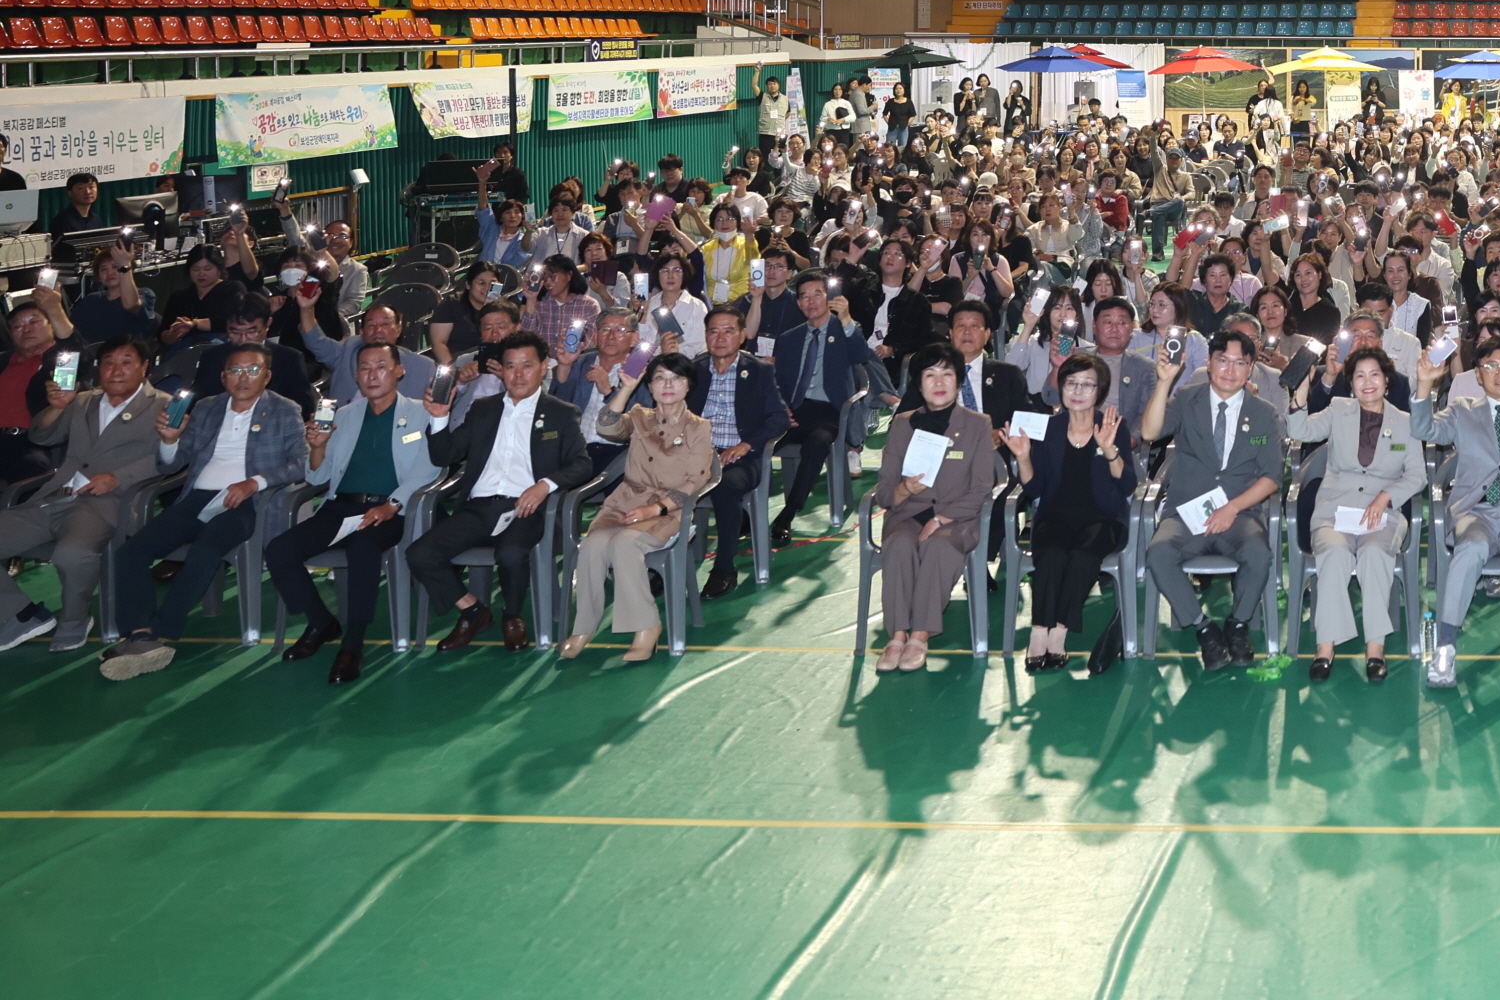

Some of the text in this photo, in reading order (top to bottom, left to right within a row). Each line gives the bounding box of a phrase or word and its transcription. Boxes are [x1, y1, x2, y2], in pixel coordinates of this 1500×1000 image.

[671, 80, 689, 94] 보성군의
[690, 79, 705, 93] 따뜻한
[437, 99, 452, 114] 함께
[452, 98, 469, 112] 키우고
[470, 97, 485, 111] 모두가
[486, 96, 500, 110] 돌보는
[556, 92, 568, 107] 꿈을
[570, 92, 582, 106] 향한
[583, 91, 597, 104] 도전,
[598, 89, 615, 103] 희망을
[616, 88, 628, 102] 향한
[258, 111, 287, 134] 공감으로
[303, 108, 328, 126] 나눔으로
[329, 109, 345, 121] 채우는
[346, 105, 363, 122] 우리
[453, 115, 470, 130] 보성군
[471, 113, 494, 129] 가족센터가
[568, 106, 634, 122] 보성지역자활센터와 함께 웃어요
[3, 116, 67, 132] 복지공감 페스티벌
[30, 135, 56, 162] 꿈과
[61, 130, 98, 158] 희망을
[103, 128, 139, 154] 키우는
[143, 125, 165, 151] 일터
